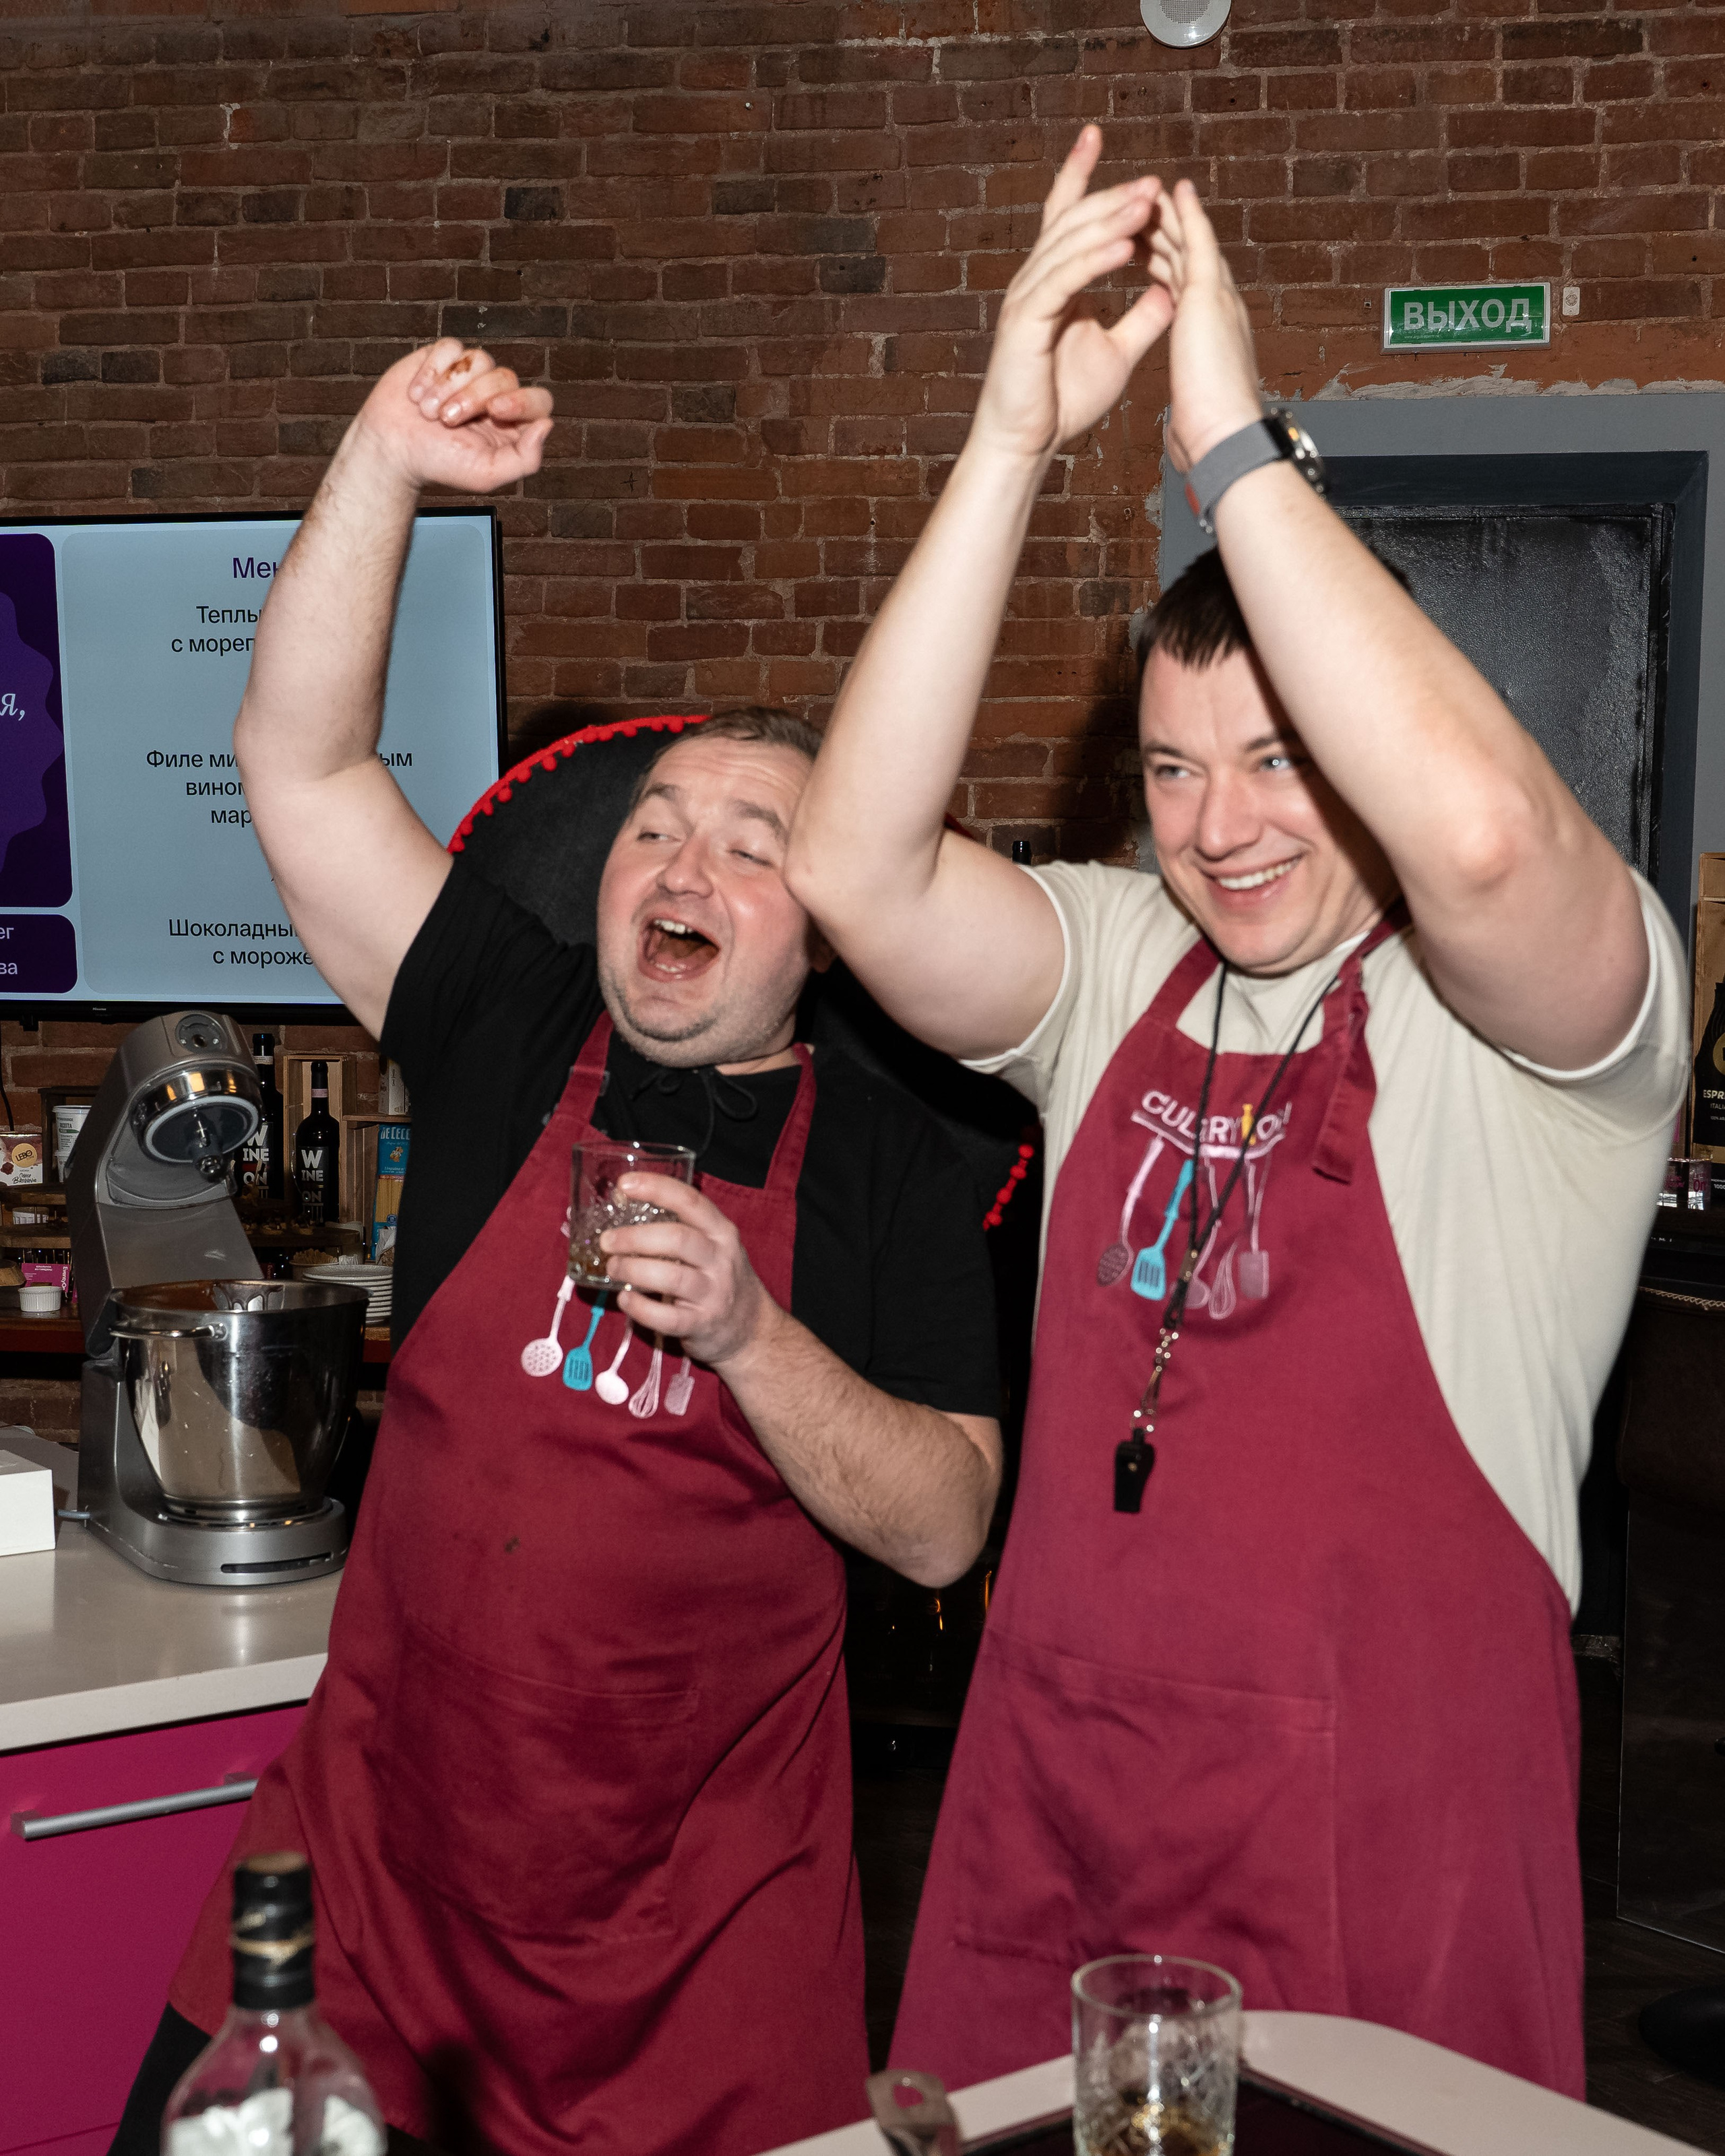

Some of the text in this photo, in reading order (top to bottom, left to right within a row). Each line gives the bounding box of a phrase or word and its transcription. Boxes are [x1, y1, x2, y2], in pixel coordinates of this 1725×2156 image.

[1404, 298, 1532, 333] ВЫХОД
[171, 638, 183, 653] с
[146, 750, 203, 768] Филе
[211, 809, 253, 828] мар
[169, 918, 299, 941] Шоколадны
[213, 950, 314, 969] с мороже
[1703, 1089, 1725, 1100] ESPR
[15, 1149, 32, 1162] LEBO
[243, 1148, 269, 1162] INE
[301, 1149, 323, 1168] W
[243, 1172, 268, 1186] ON
[301, 1170, 323, 1182] INE
[303, 1191, 321, 1203] ON
